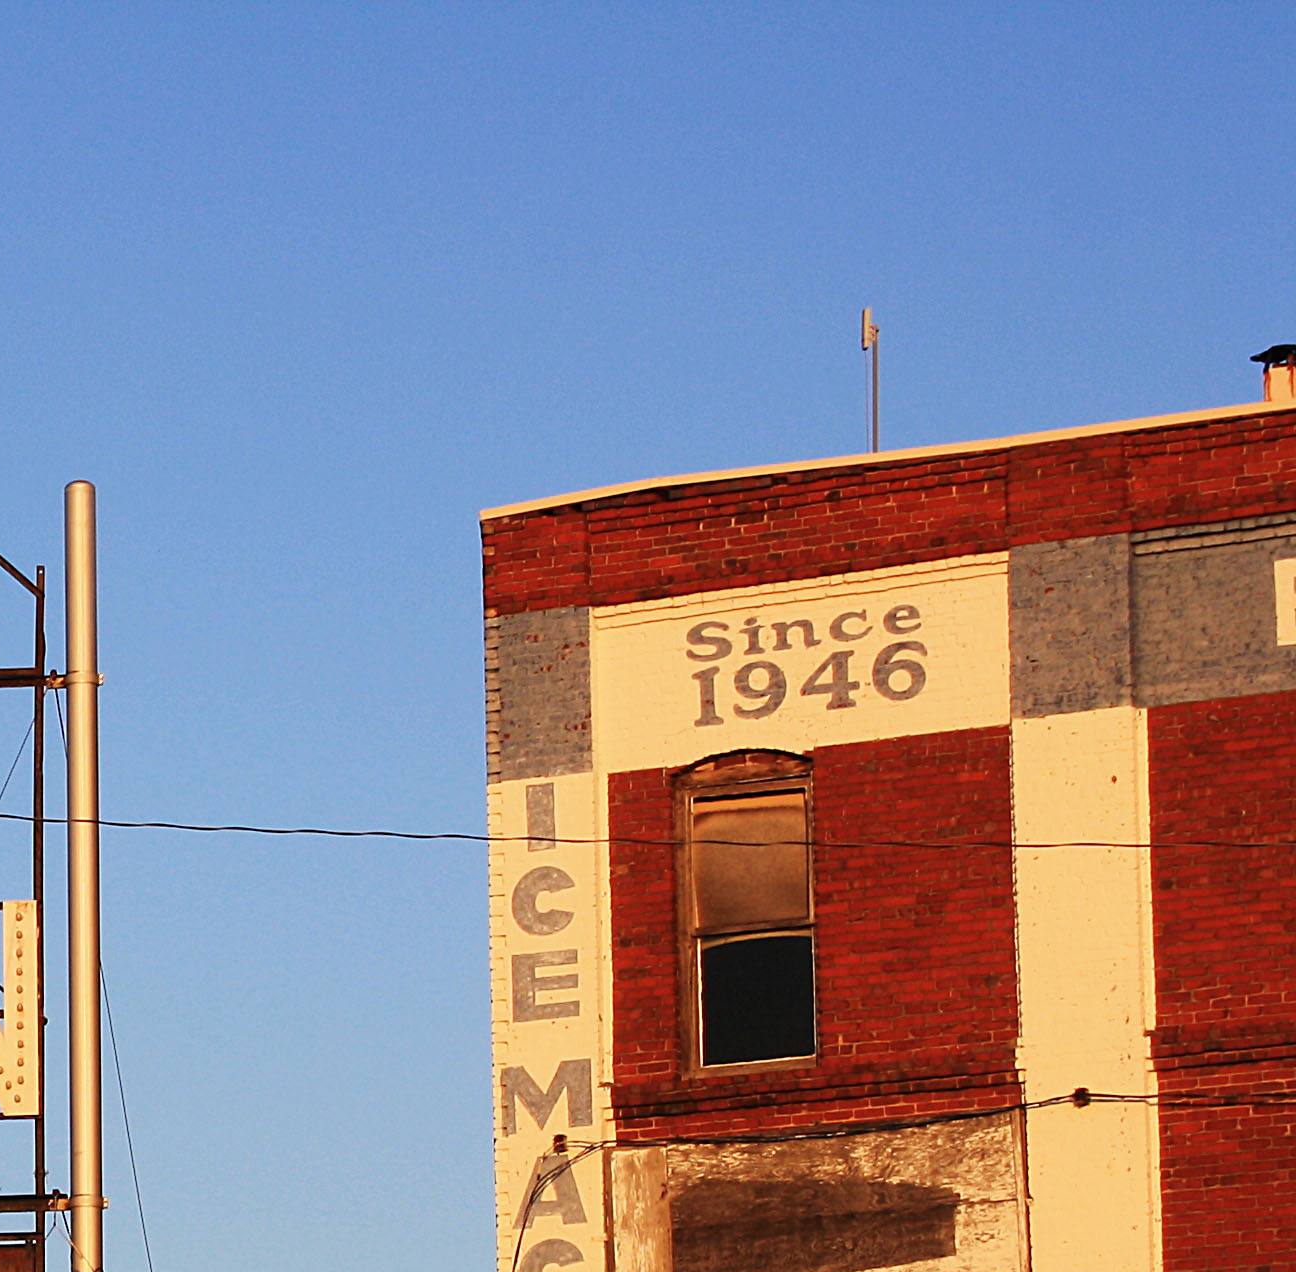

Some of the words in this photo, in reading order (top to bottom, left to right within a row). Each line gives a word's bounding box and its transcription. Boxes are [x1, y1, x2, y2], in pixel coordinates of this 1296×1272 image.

[685, 603, 923, 662] Since
[693, 640, 929, 727] 1946
[511, 782, 579, 1024] ICE
